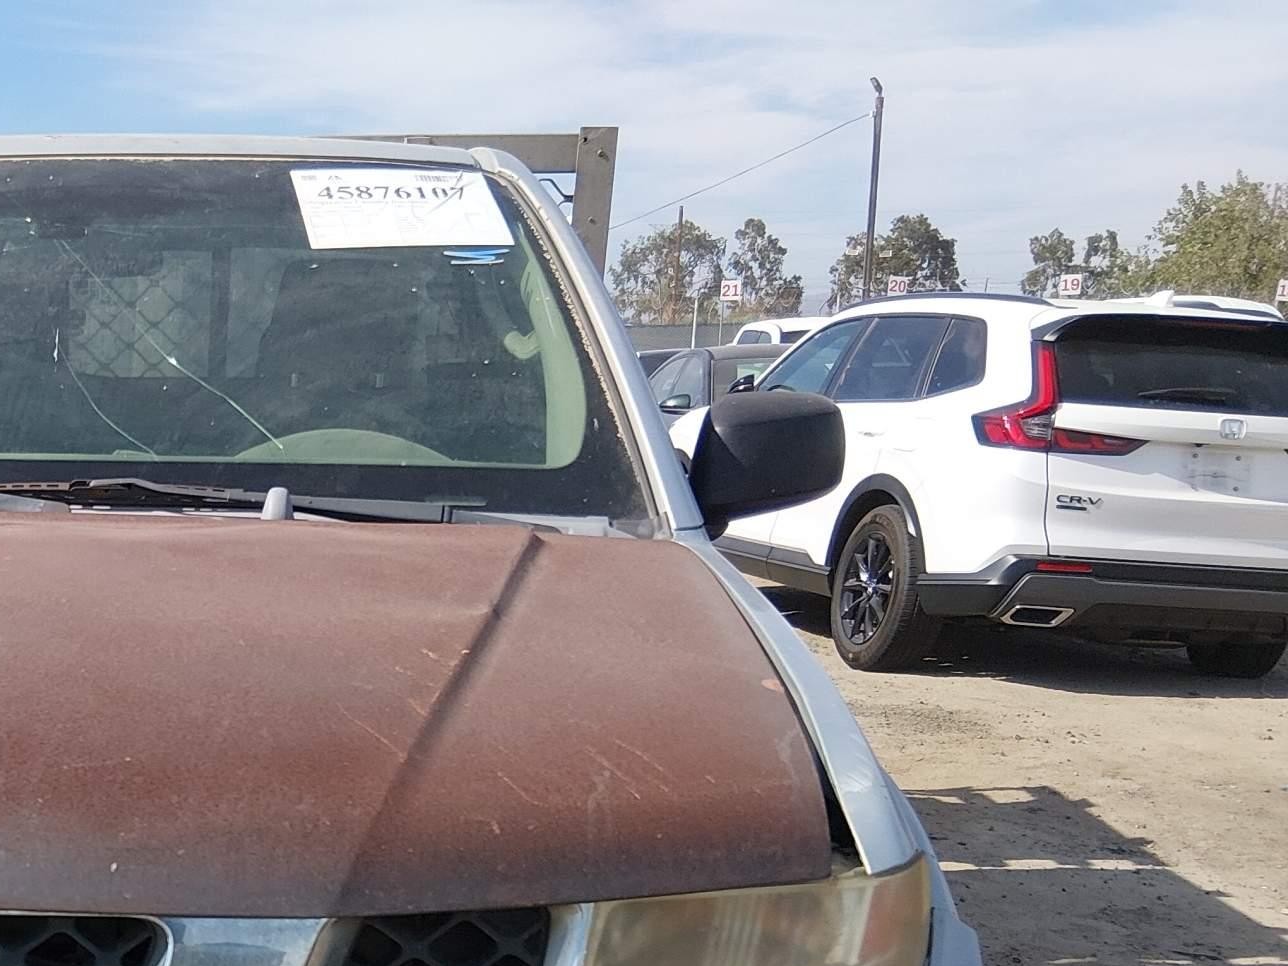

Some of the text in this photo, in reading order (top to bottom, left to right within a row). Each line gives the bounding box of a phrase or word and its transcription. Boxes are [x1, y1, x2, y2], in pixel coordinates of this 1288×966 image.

[317, 185, 465, 201] 45876107
[722, 283, 740, 297] 21
[889, 279, 907, 293] 20
[1062, 278, 1081, 292] 19
[1056, 494, 1103, 506] CR-V
